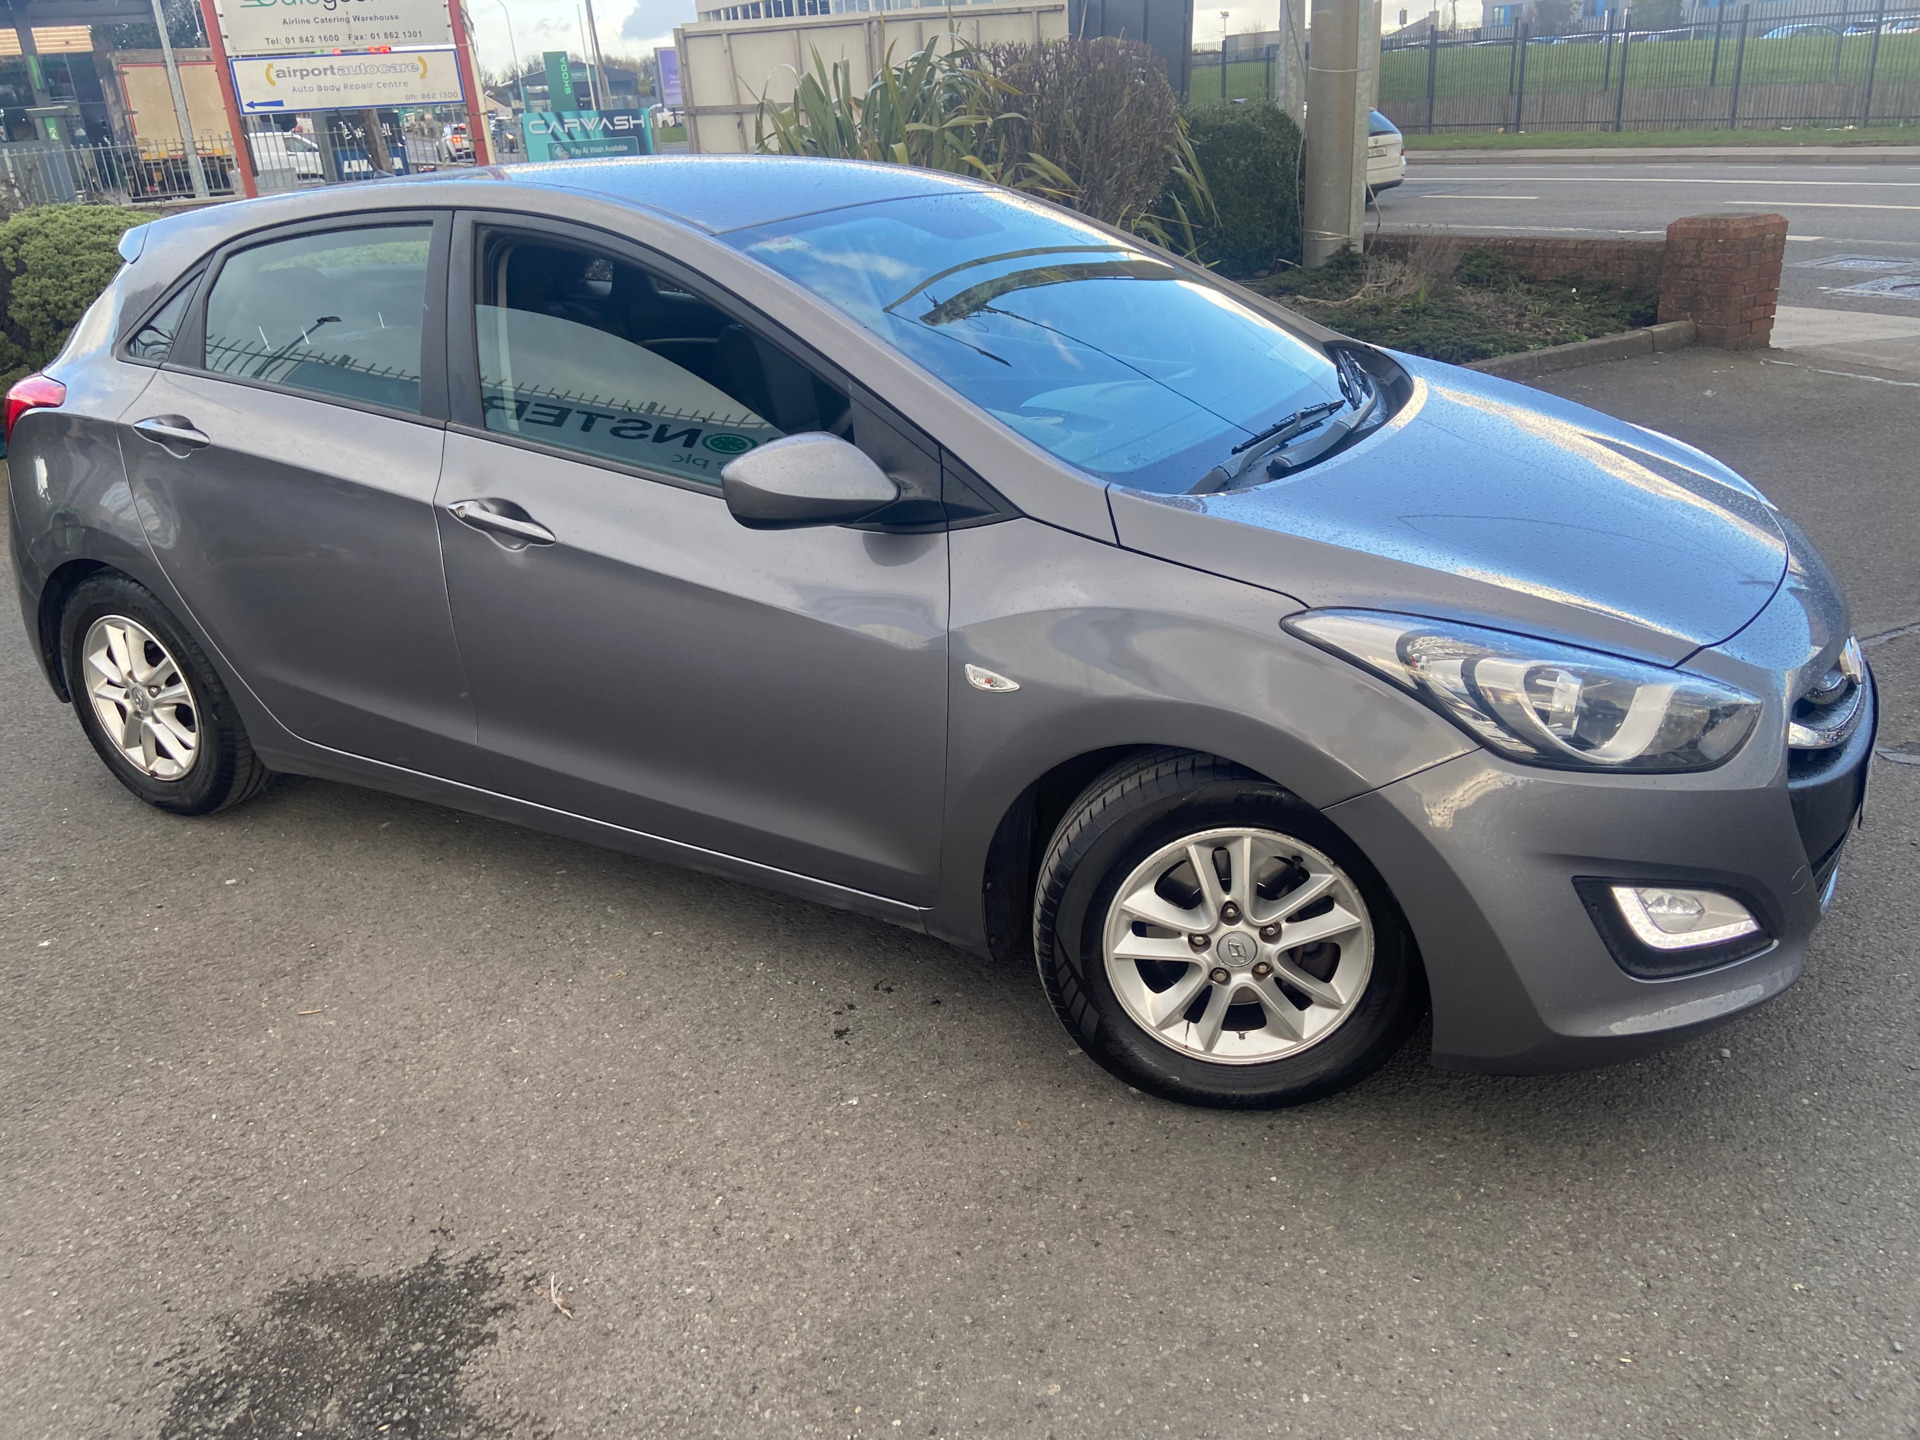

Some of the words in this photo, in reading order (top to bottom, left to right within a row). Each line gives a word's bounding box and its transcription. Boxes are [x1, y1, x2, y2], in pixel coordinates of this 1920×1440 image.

[282, 16, 311, 25] Airline
[313, 14, 350, 24] Catering
[352, 13, 400, 22] Warehouse
[265, 36, 283, 45] Tel:
[285, 35, 296, 44] 01
[299, 34, 316, 43] 842
[318, 33, 340, 42] 1600
[348, 32, 368, 41] Fax:
[370, 31, 381, 41] 01
[383, 31, 399, 40] 862
[403, 30, 423, 39] 1301
[275, 61, 420, 80] airportautocare
[292, 84, 314, 94] Auto
[317, 82, 341, 92] Body
[343, 81, 374, 91] Repair
[376, 79, 409, 89] Centre
[405, 93, 419, 102] ph:
[421, 92, 437, 100] 862
[439, 90, 459, 100] 1300
[529, 115, 646, 135] CARWASH
[570, 147, 582, 155] Pay
[589, 145, 604, 153] Wash
[605, 144, 628, 152] Available
